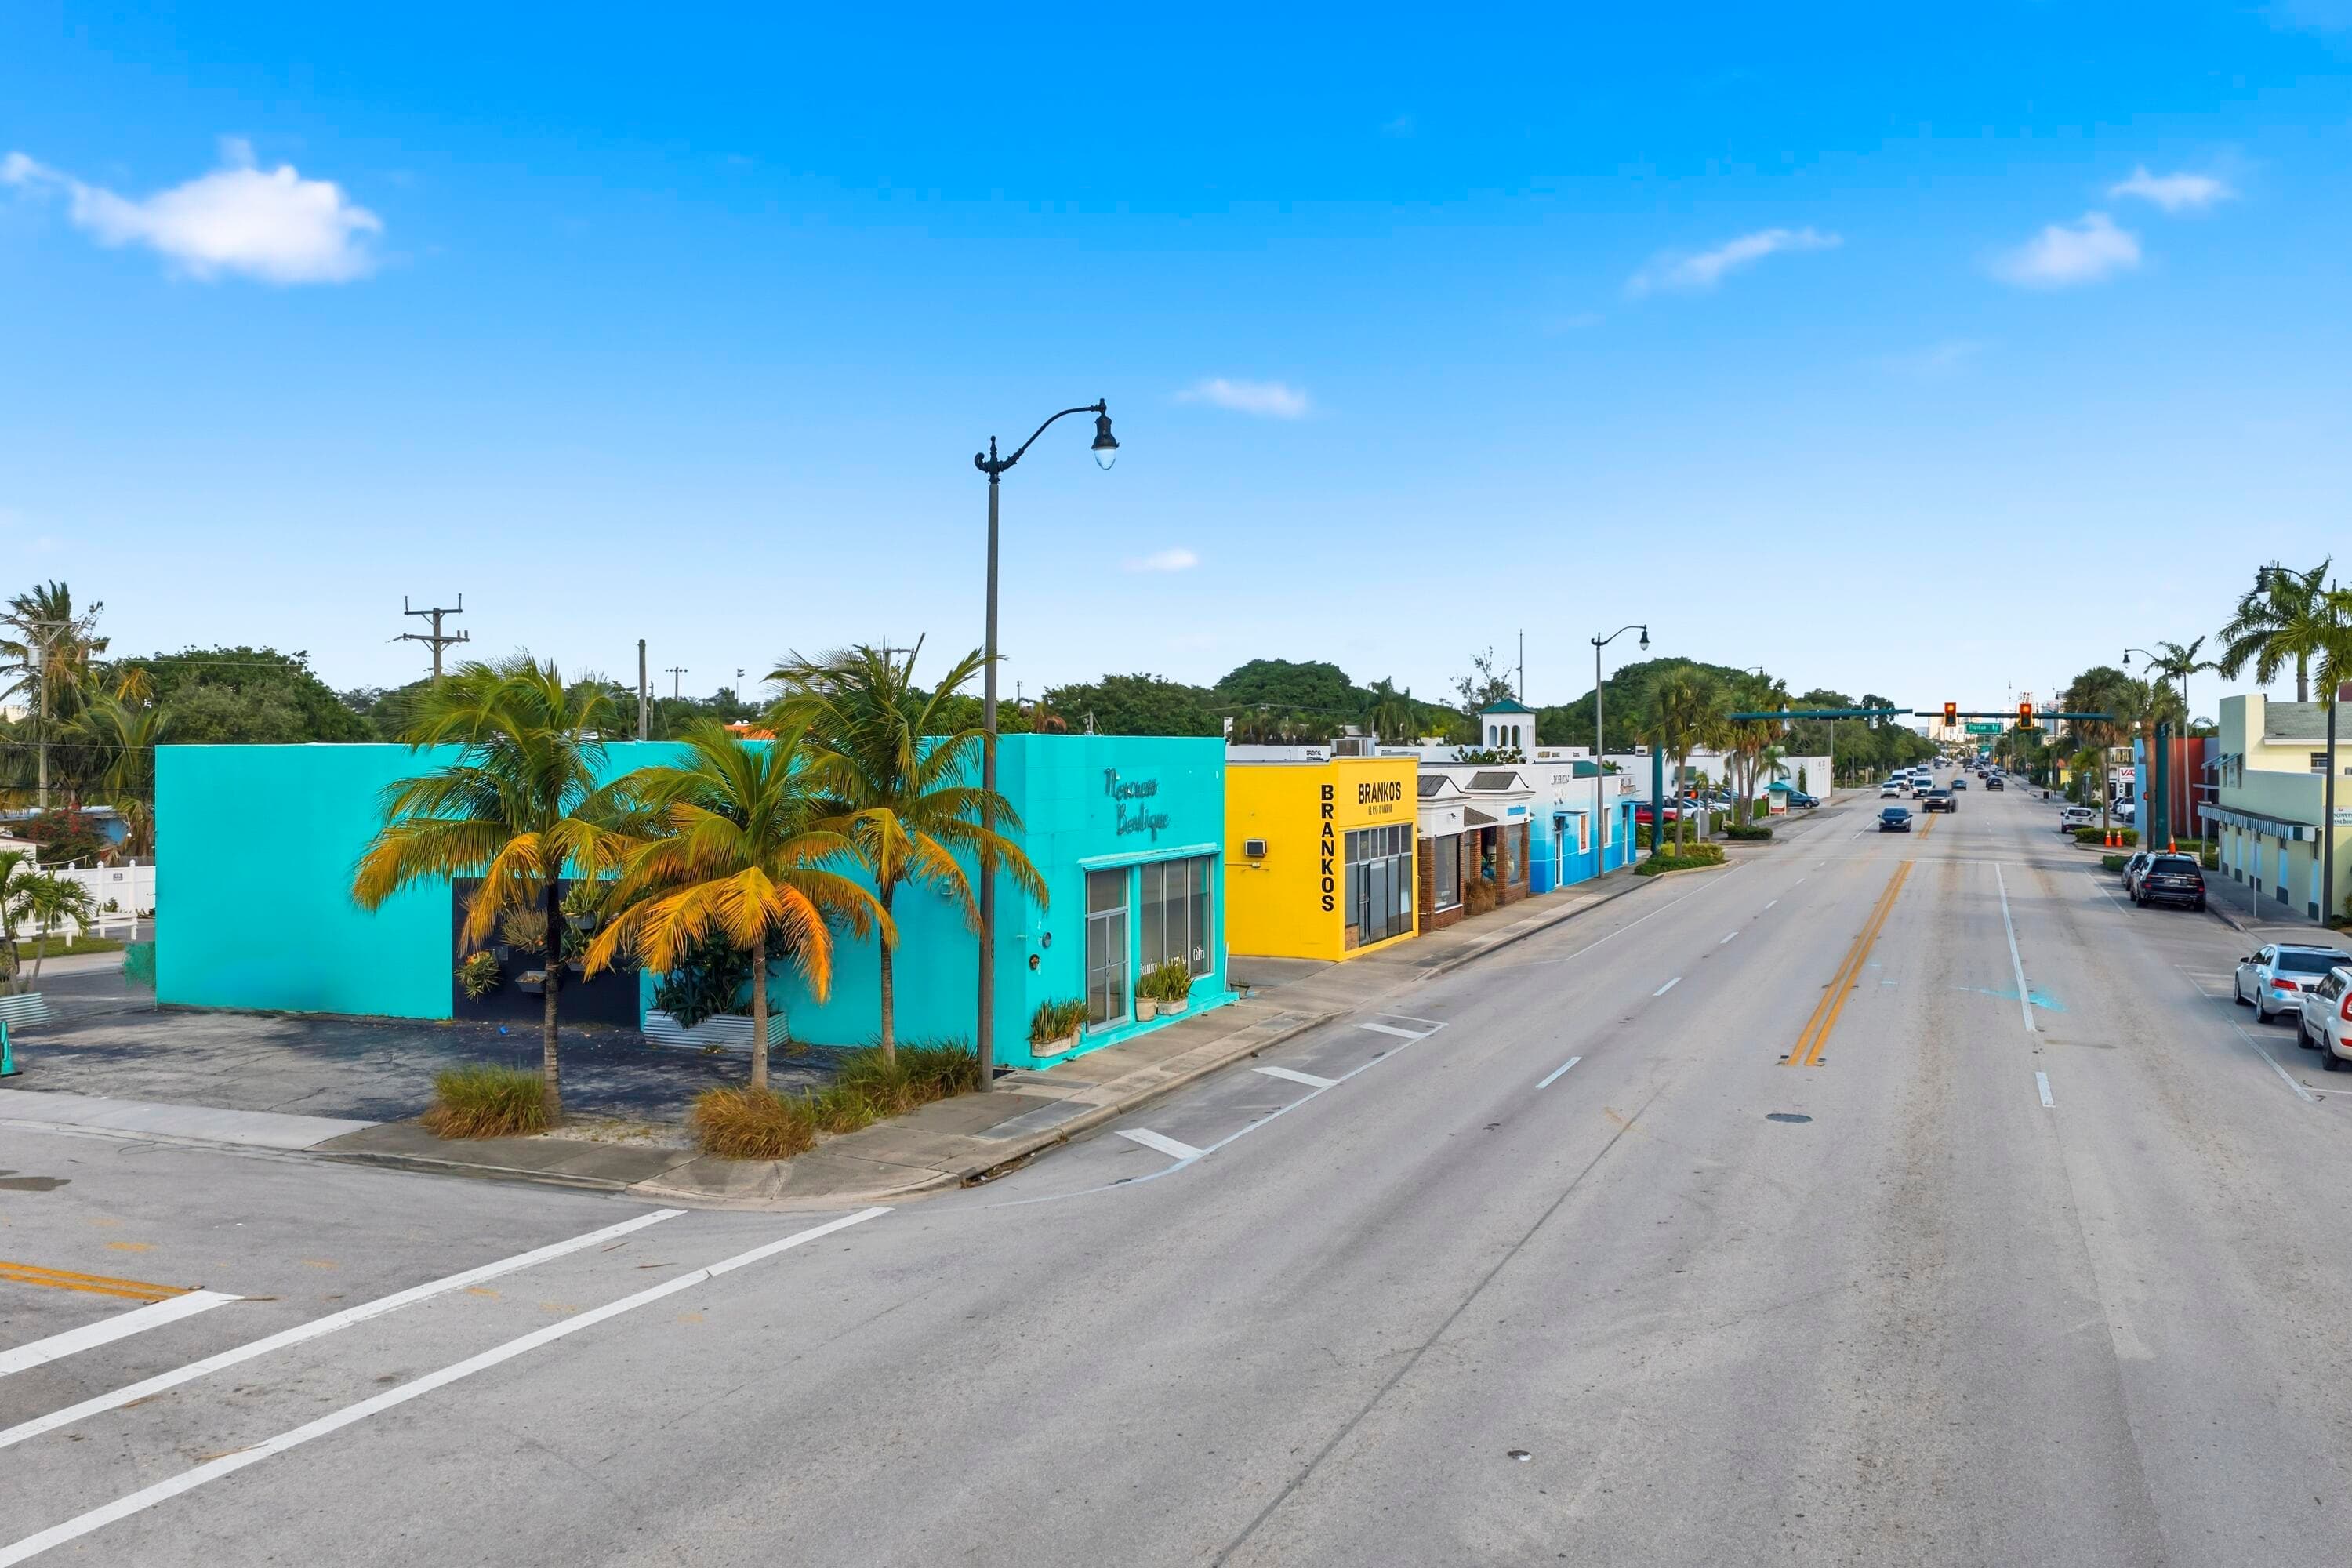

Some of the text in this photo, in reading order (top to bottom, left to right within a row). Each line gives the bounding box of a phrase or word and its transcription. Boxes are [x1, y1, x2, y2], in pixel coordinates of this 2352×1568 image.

[1359, 781, 1401, 804] BRANKO'S
[1116, 802, 1171, 842] Boutique
[1321, 784, 1334, 912] BRANKOS
